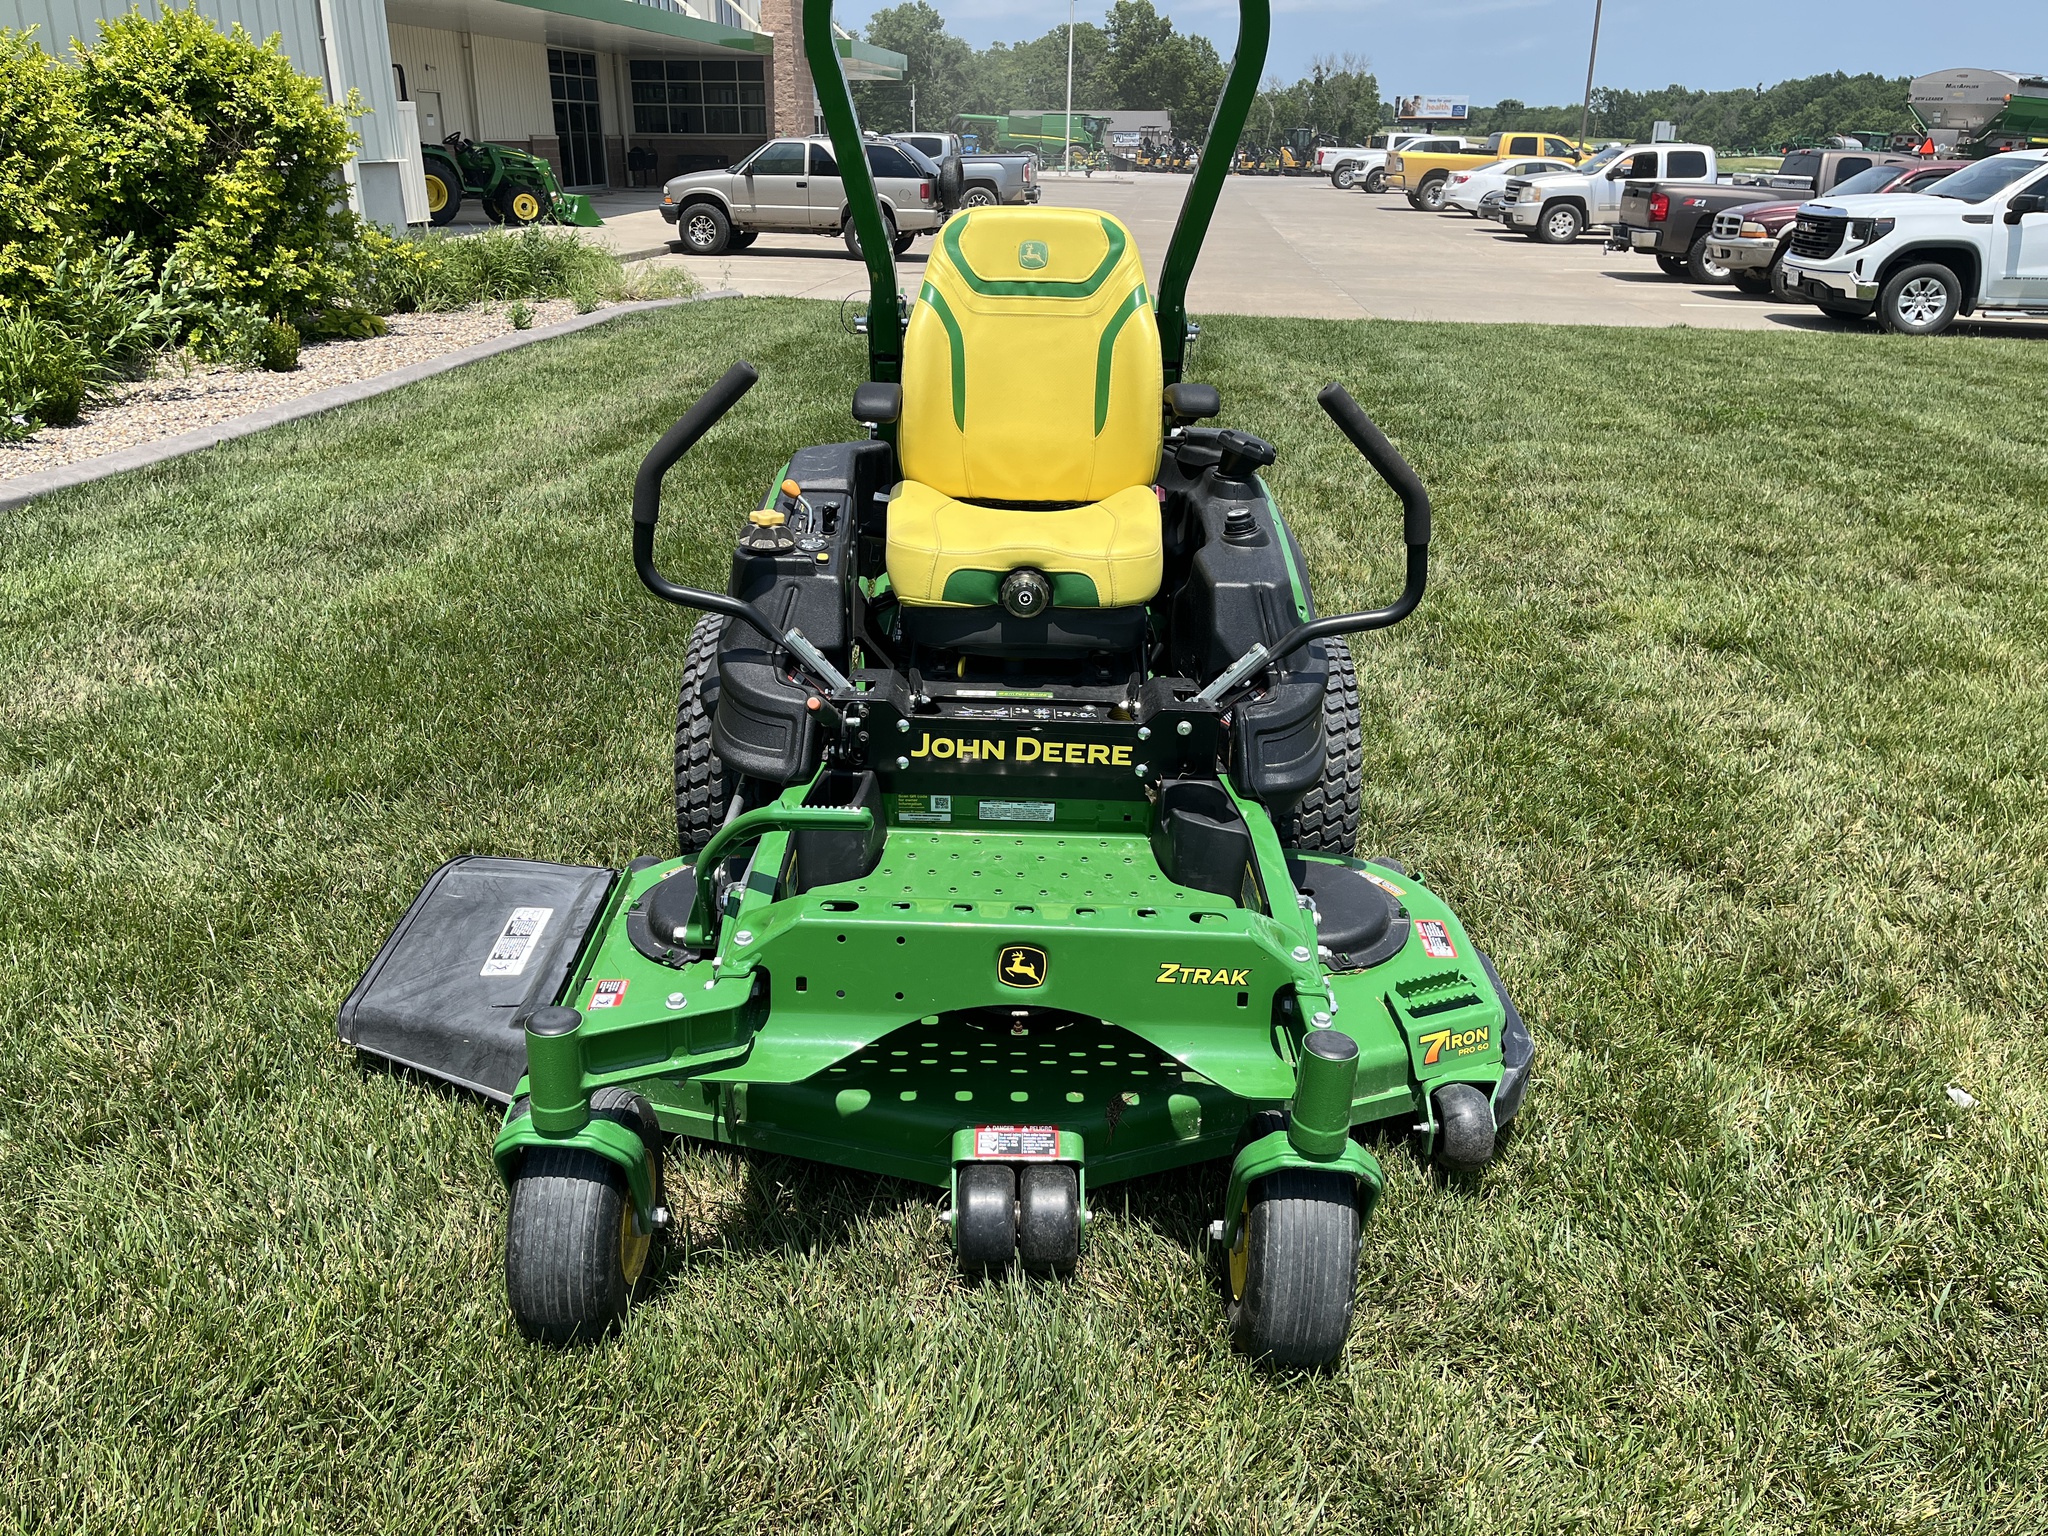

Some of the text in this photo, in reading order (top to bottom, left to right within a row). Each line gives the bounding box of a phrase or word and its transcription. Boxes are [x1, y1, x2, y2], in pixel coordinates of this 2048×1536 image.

[910, 732, 1134, 767] JOHN DEERE
[1156, 963, 1253, 986] ZTRAK
[1458, 1042, 1489, 1056] PRO 60
